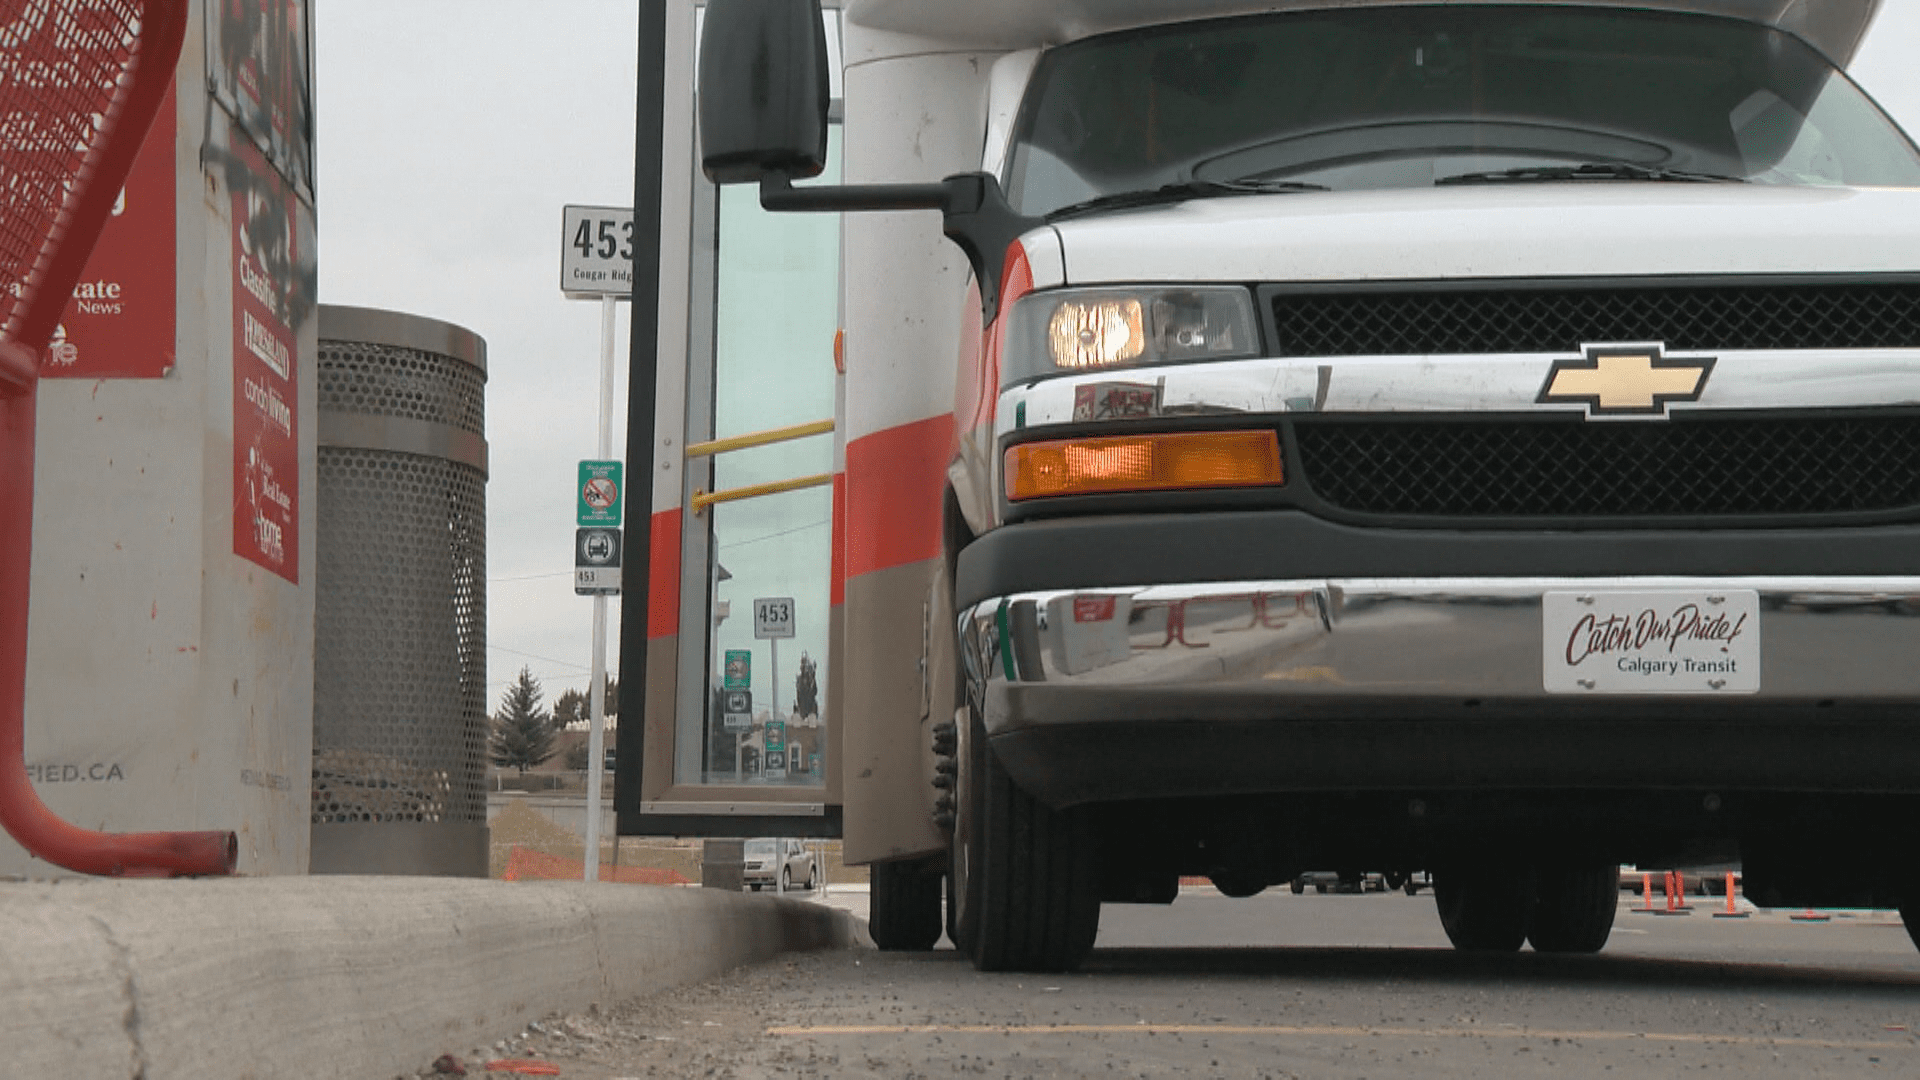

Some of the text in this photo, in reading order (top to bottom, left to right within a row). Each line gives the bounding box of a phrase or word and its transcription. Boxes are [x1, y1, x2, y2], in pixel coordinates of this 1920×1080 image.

[574, 219, 634, 260] 453
[574, 267, 606, 282] Cougar
[78, 300, 121, 314] News
[759, 604, 788, 622] 453
[1566, 603, 1747, 666] Catch Our Pride!
[1617, 657, 1737, 675] Calgary Transit
